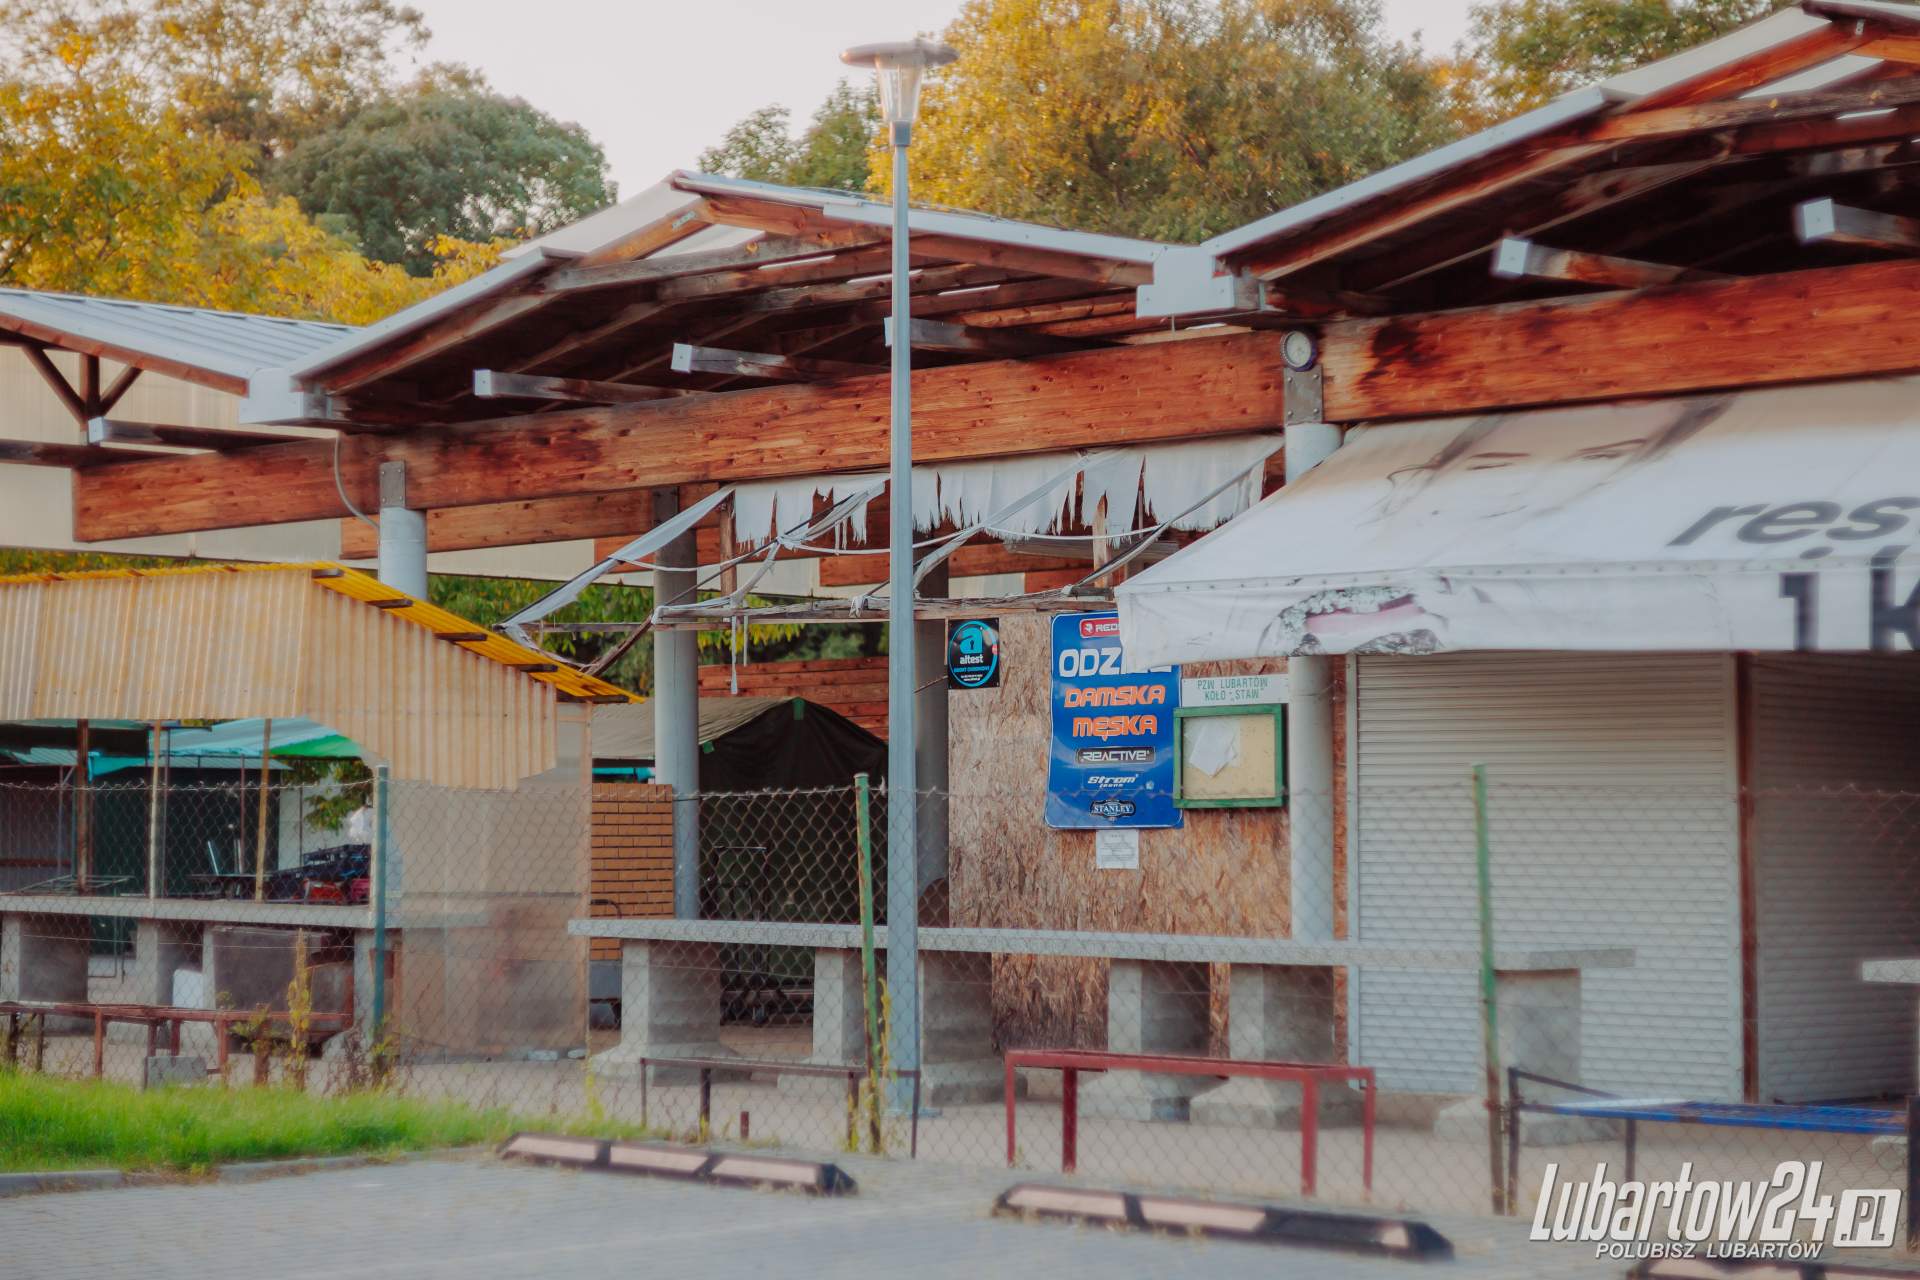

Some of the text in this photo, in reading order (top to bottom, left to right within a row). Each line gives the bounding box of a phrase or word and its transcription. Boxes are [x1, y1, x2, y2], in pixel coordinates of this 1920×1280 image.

[1064, 685, 1166, 708] DAMSKA
[1081, 750, 1147, 761] REACTIVE
[1094, 805, 1131, 813] STANLEY
